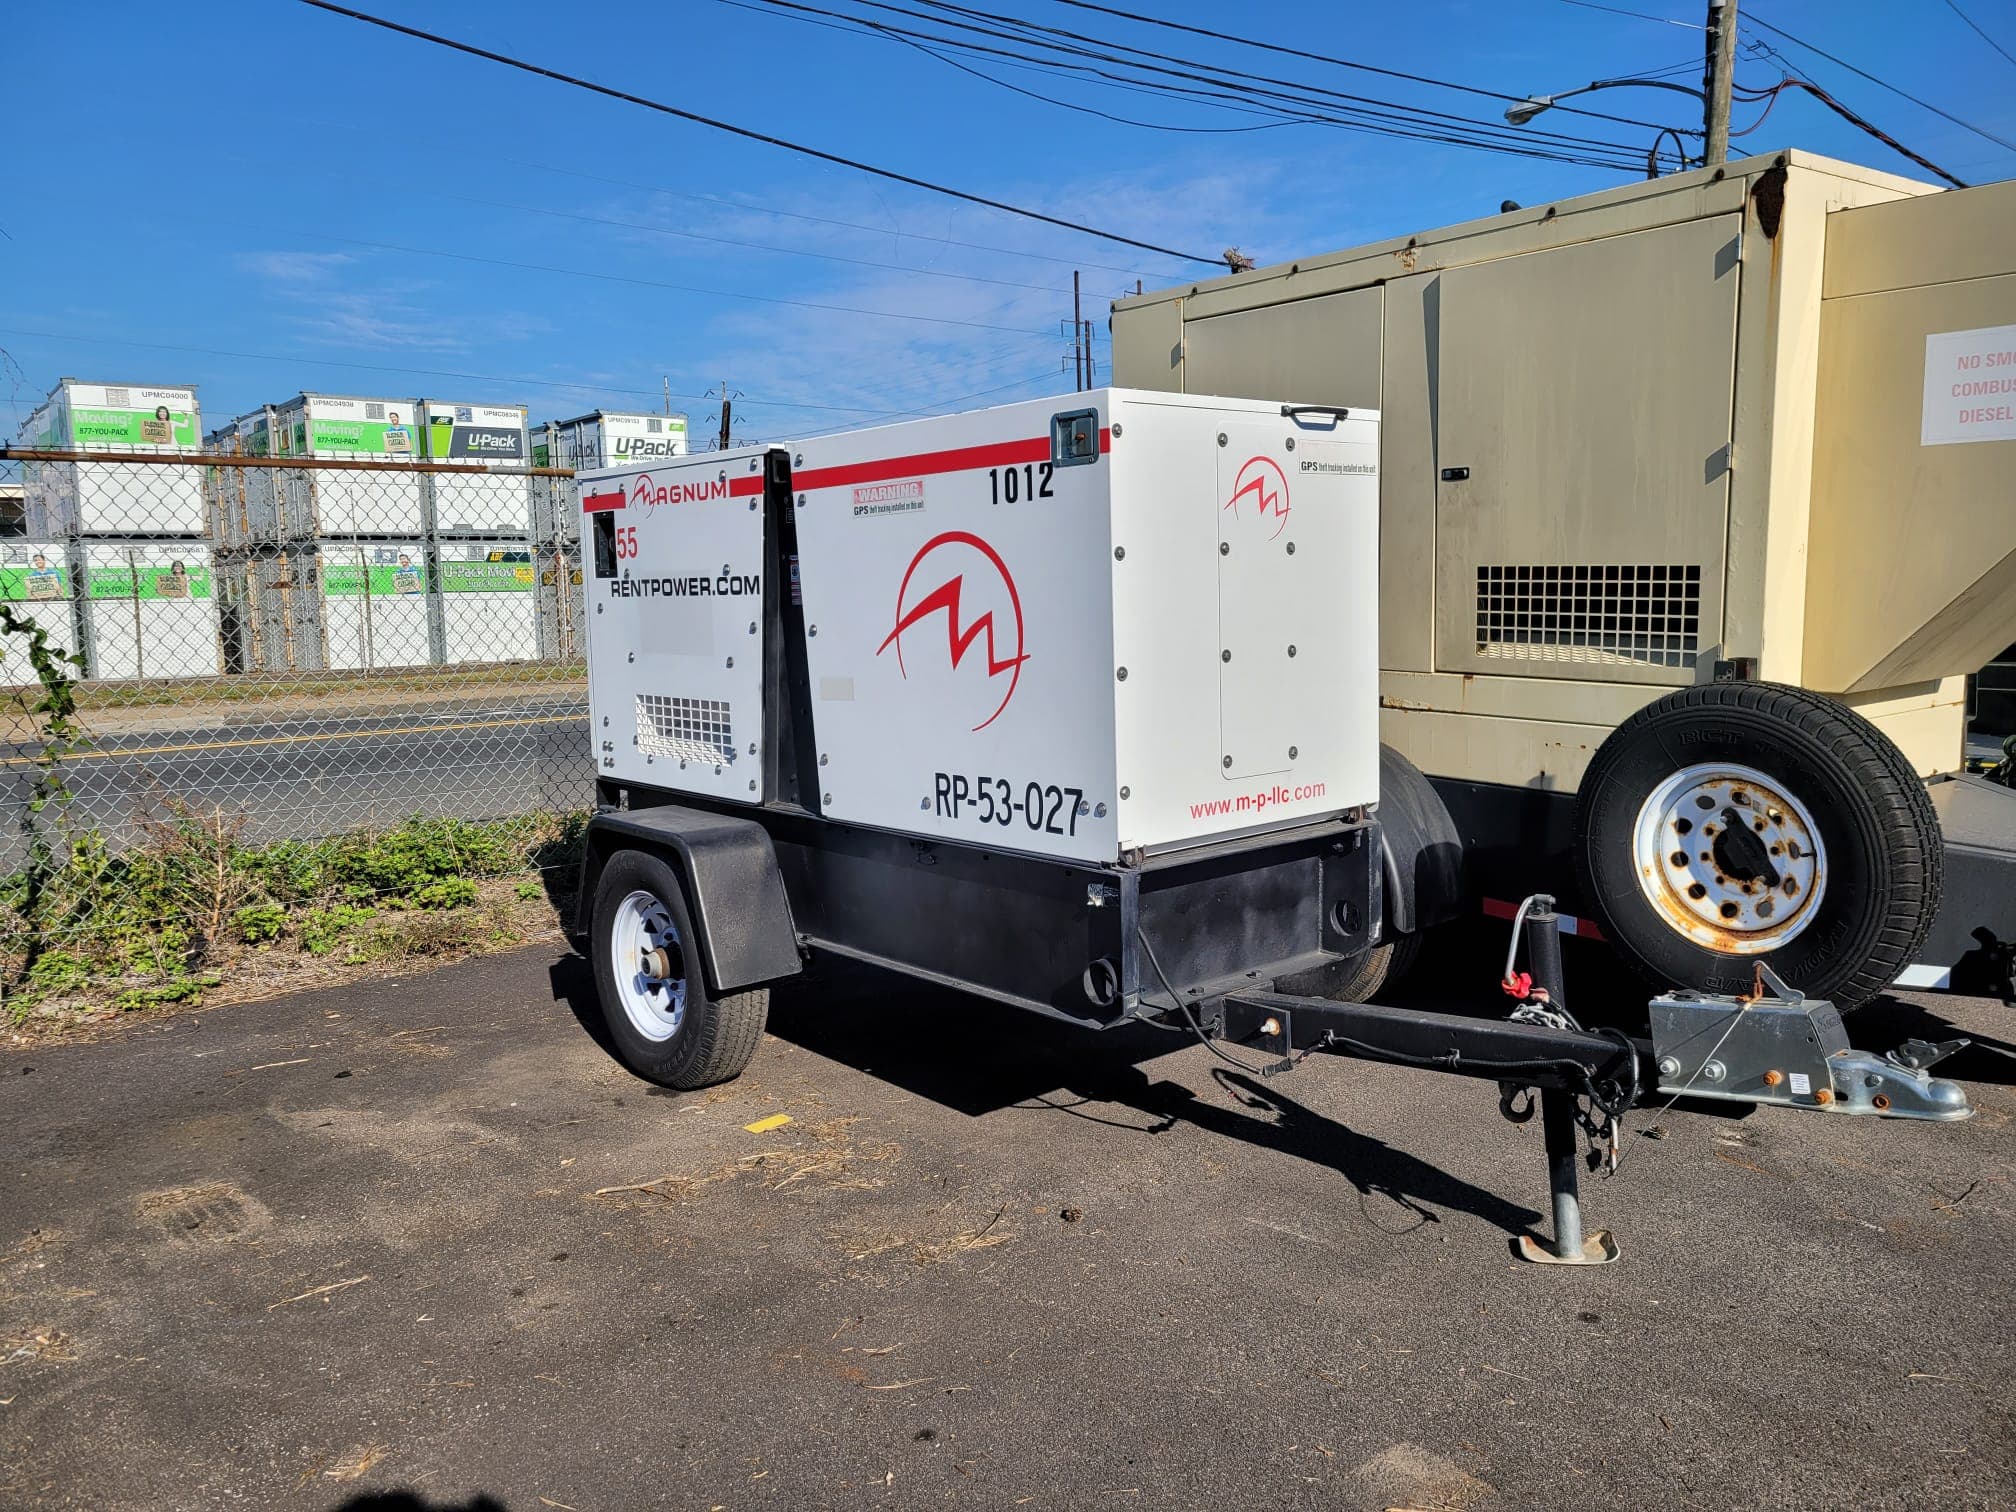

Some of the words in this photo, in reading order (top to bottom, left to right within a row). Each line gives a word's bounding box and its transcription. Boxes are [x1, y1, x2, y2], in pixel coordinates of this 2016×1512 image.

[1957, 355, 1981, 370] NO
[74, 410, 134, 427] Moving?
[1959, 406, 2014, 424] DIESEL
[79, 427, 129, 436] 877-YOU-PACK
[315, 422, 365, 439] Moving?
[1300, 460, 1319, 472] GPS
[989, 462, 1055, 505] 1012
[858, 482, 919, 504] WARNING
[853, 505, 869, 516] GPS
[616, 526, 639, 560] 55
[610, 574, 761, 598] RENTPOWER.COM
[935, 772, 1083, 837] RP-53-027
[1190, 783, 1326, 819] www.m-p-llc.com
